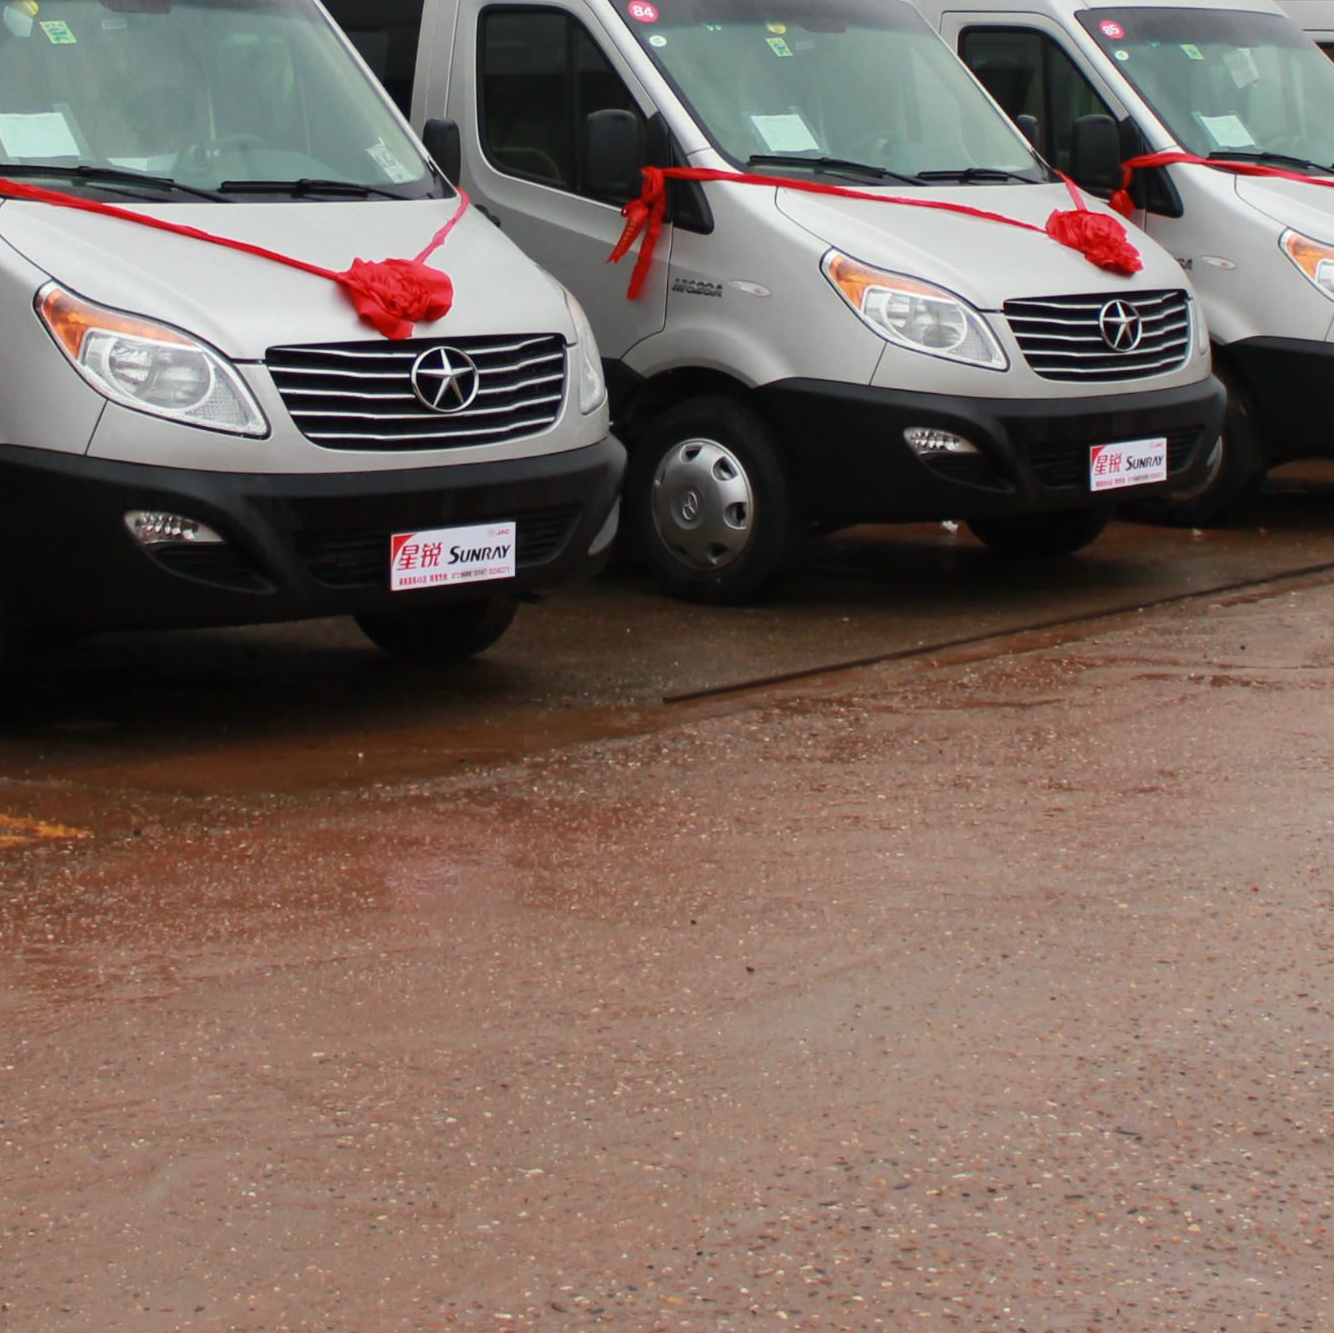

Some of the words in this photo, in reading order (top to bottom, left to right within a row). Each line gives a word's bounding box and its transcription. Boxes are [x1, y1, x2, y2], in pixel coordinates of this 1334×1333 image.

[632, 5, 655, 18] 84
[396, 541, 443, 571] 星锐
[447, 544, 512, 565] SUNRAY
